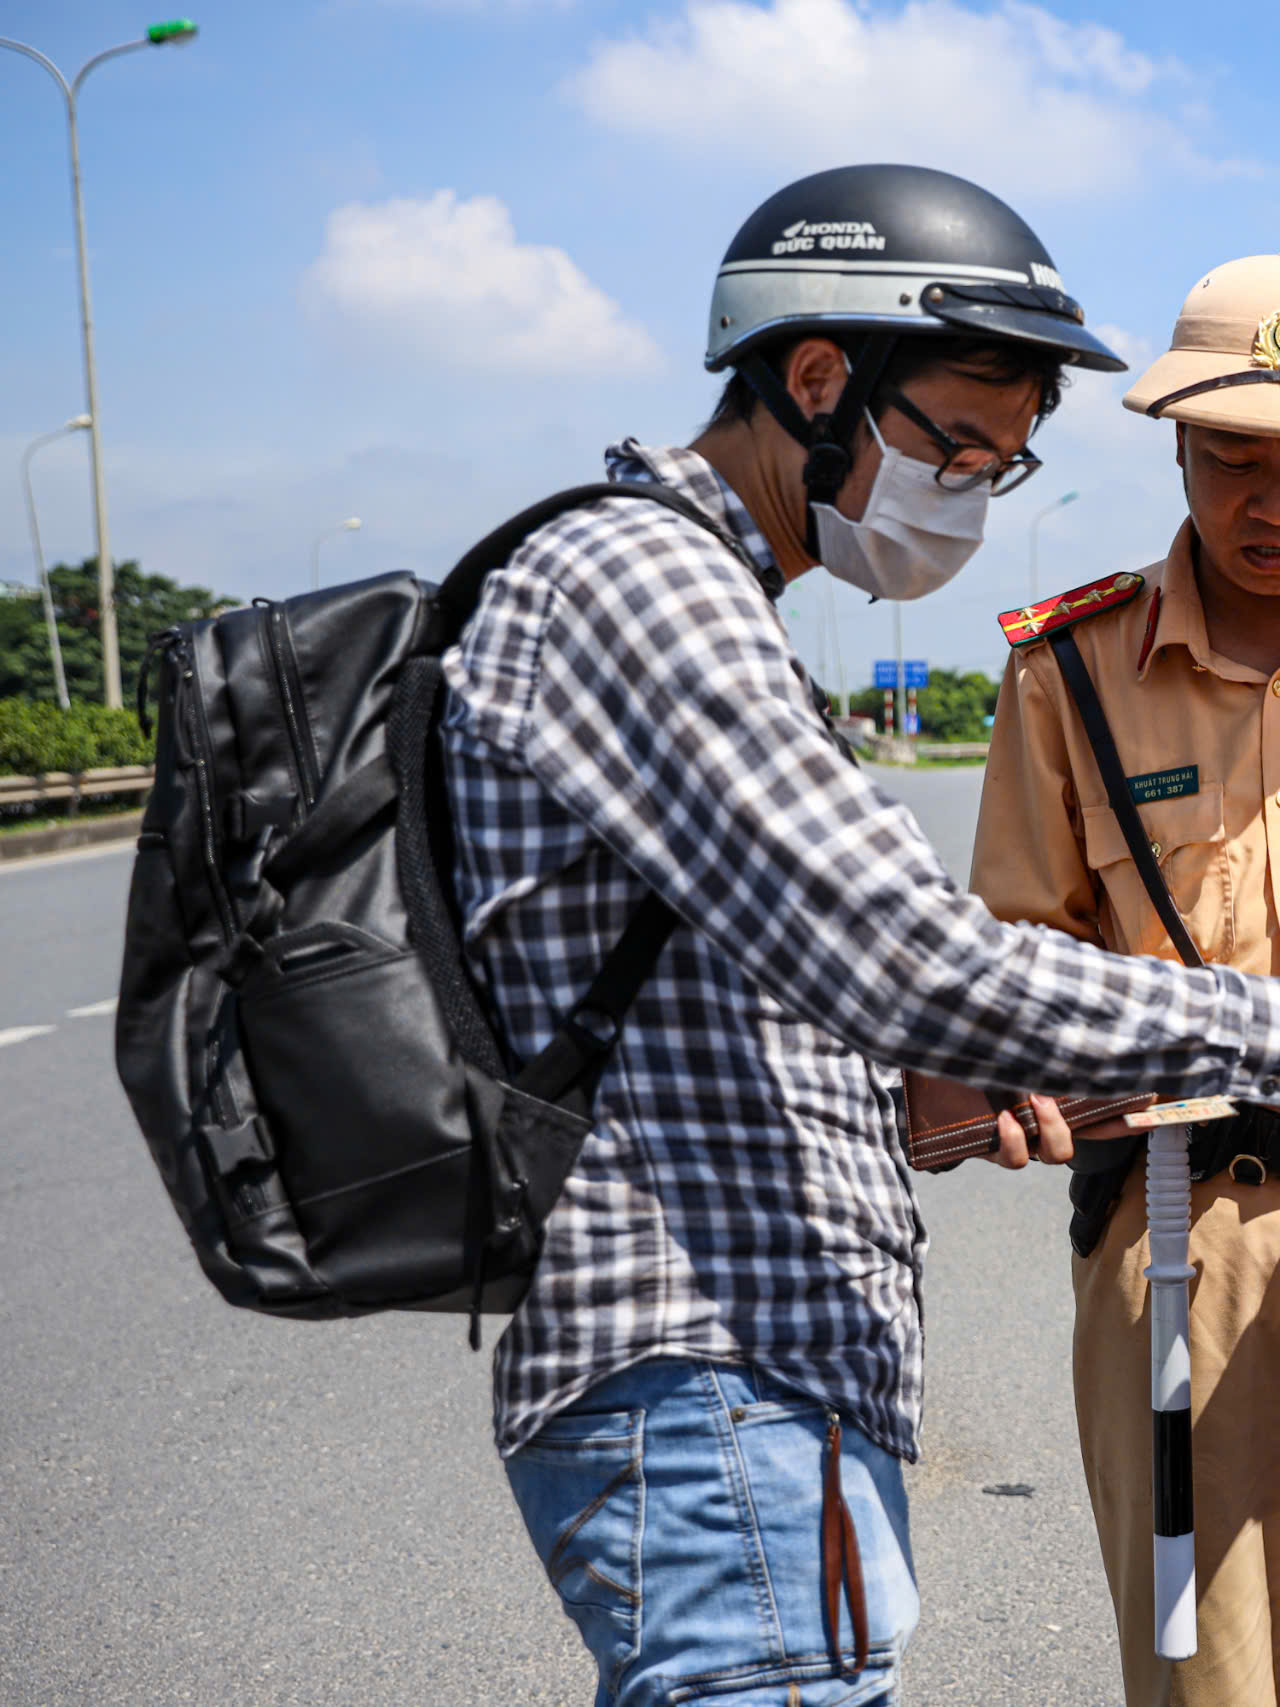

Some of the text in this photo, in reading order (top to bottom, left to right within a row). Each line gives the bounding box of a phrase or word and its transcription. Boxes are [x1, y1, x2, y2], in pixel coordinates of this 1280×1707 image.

[803, 222, 876, 235] HONDA
[1158, 773, 1180, 785] TRUNG
[1144, 784, 1184, 798] 661 387
